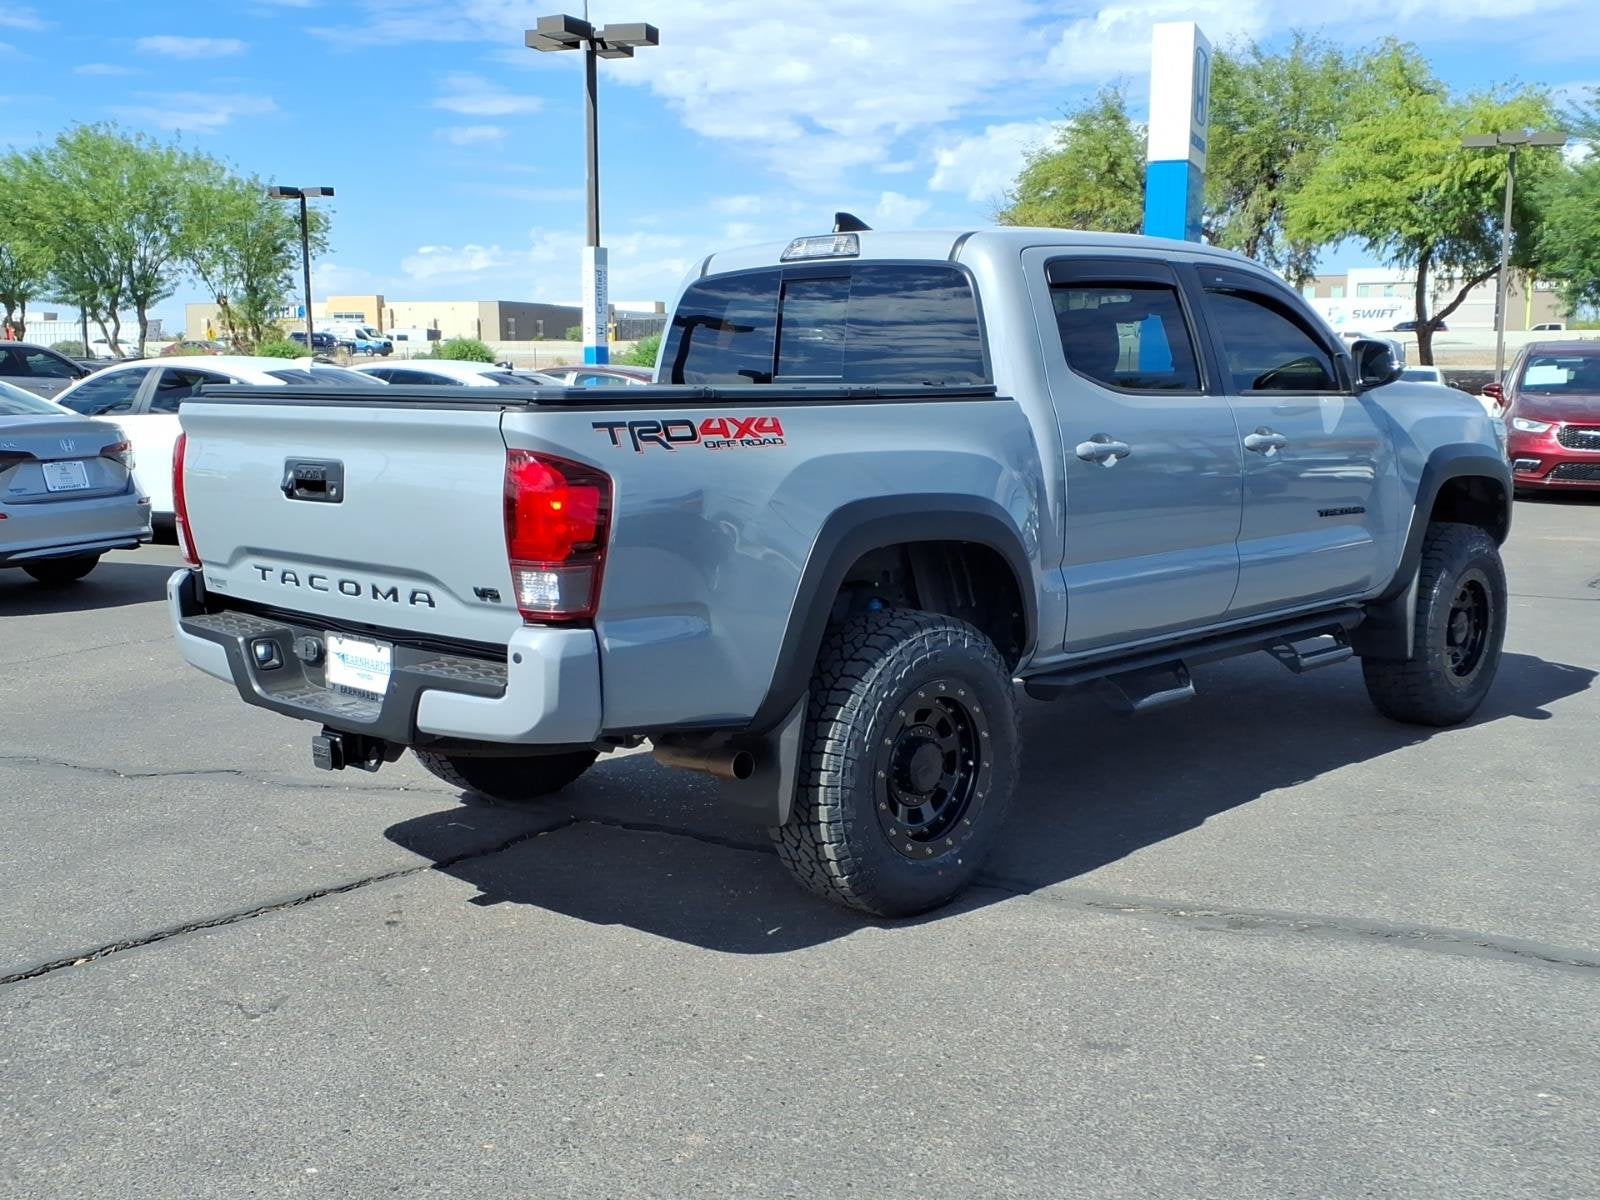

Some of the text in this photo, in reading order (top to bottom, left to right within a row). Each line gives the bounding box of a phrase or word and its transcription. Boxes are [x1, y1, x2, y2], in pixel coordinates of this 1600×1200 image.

[1352, 308, 1398, 319] SWIFT
[592, 419, 700, 453] TRD
[704, 437, 785, 449] OFF ROAD
[253, 564, 436, 608] TACOMA
[473, 586, 502, 603] V6
[340, 685, 379, 701] EARNHARDT
